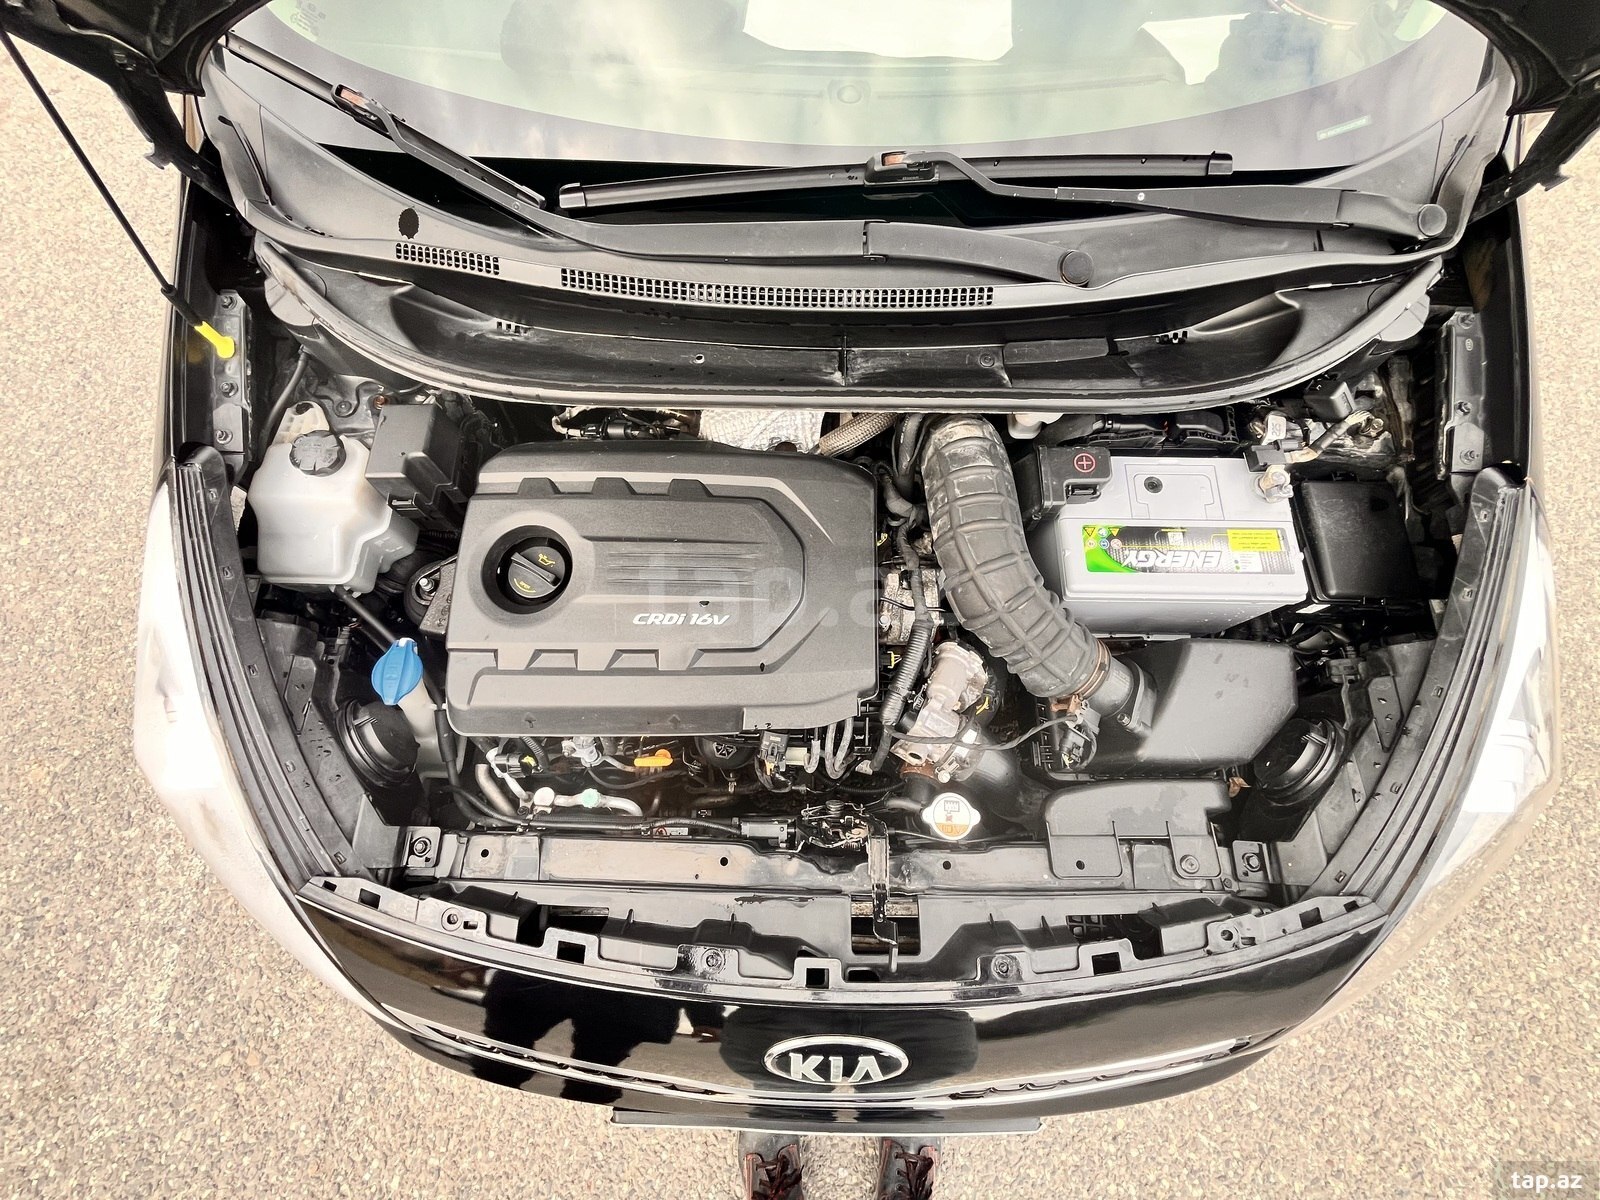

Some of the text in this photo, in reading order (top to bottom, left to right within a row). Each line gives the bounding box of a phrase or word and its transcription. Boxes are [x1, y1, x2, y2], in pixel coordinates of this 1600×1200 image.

[1122, 549, 1223, 569] ENERGY
[632, 612, 687, 625] CRDi
[789, 1052, 884, 1083] KIA
